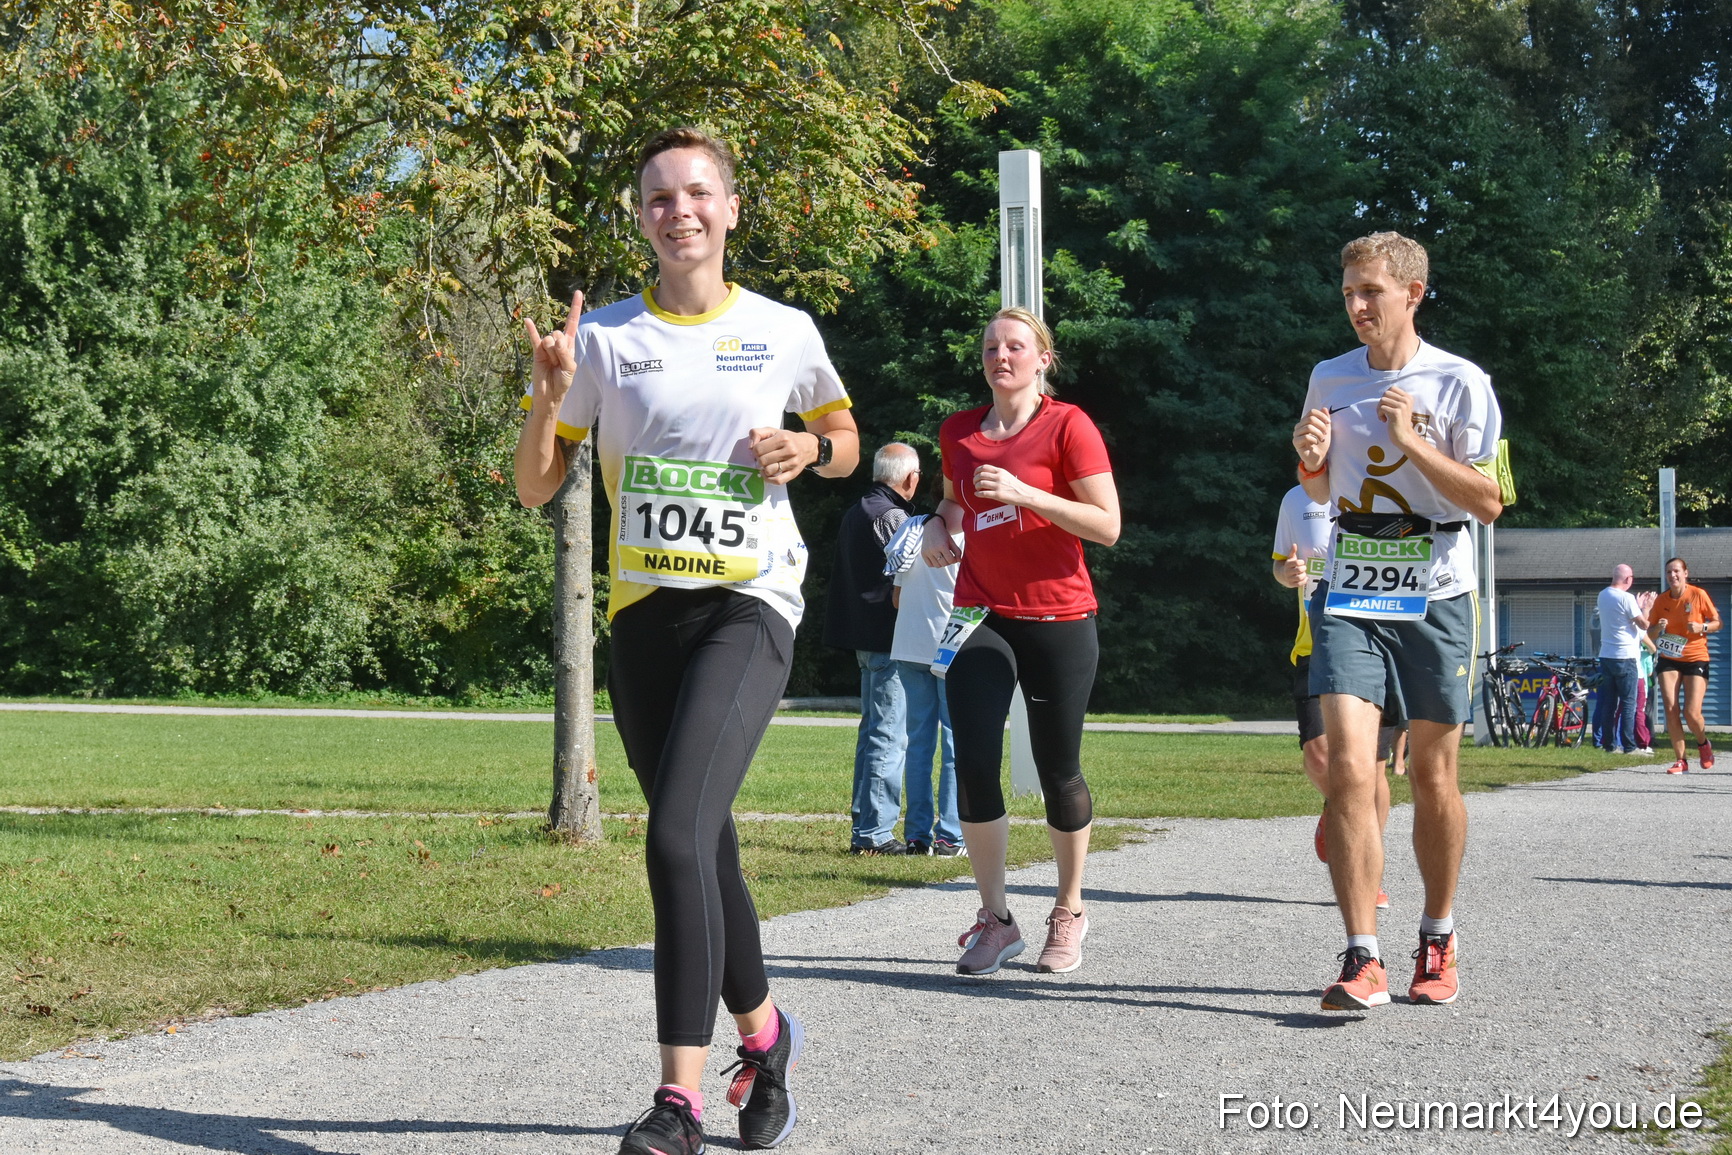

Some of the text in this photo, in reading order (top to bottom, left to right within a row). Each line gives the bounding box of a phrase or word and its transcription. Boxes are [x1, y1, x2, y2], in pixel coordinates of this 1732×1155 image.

[716, 339, 740, 351] 20
[716, 354, 774, 362] Neumarkter
[620, 360, 663, 374] BOCK
[716, 363, 763, 372] Stadtlauf
[633, 464, 751, 497] BOCK
[986, 511, 1004, 523] DEHN
[637, 502, 746, 547] 1045
[1343, 539, 1422, 559] BOCK
[644, 553, 726, 576] NADINE
[1342, 565, 1418, 591] 2294
[1349, 598, 1404, 611] DANIEL
[1659, 639, 1680, 653] 2611
